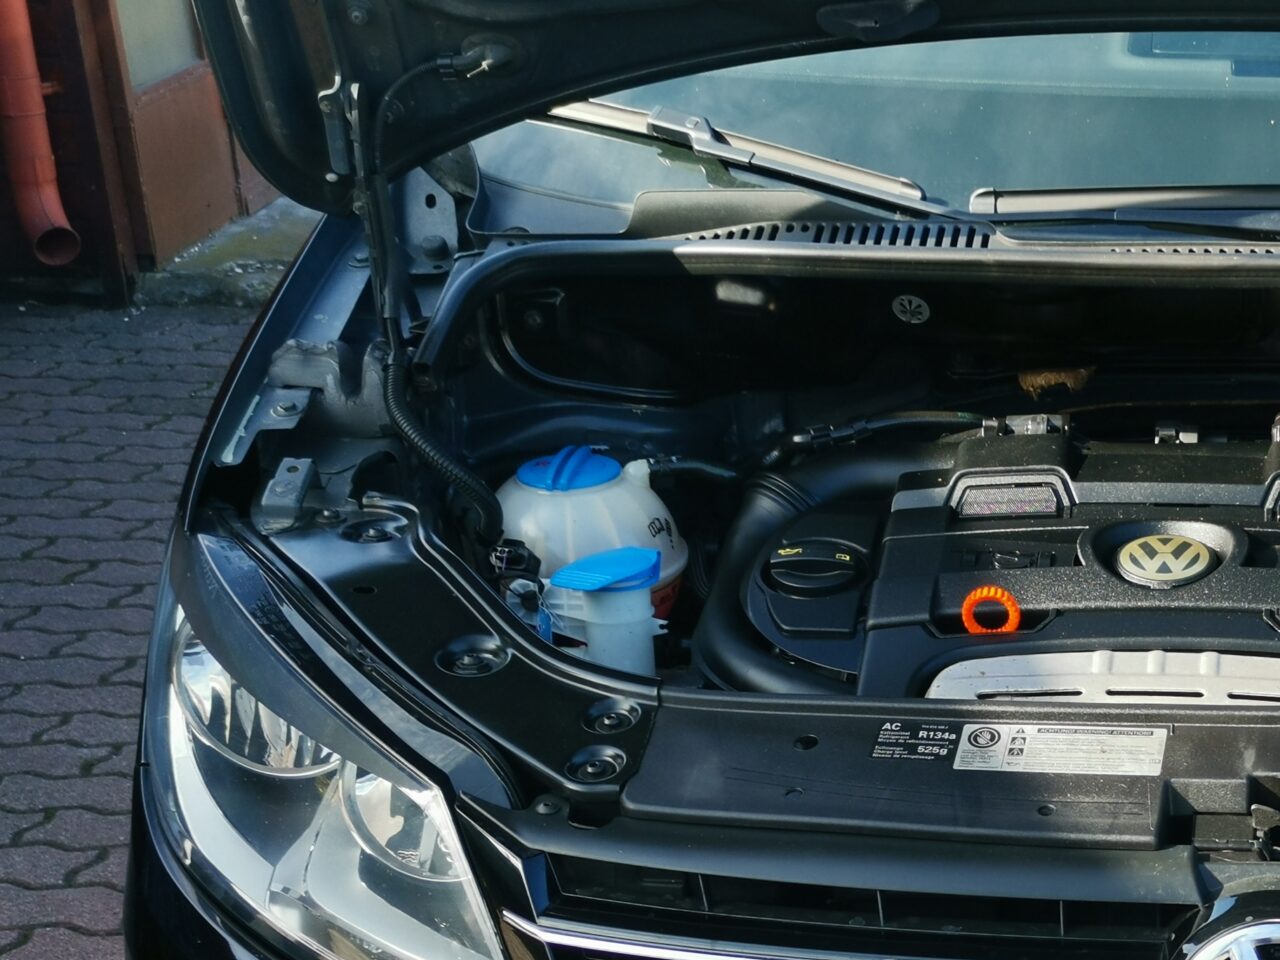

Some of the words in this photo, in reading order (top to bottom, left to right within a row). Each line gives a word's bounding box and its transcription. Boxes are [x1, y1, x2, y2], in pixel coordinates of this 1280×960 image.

[881, 722, 902, 730] AC
[918, 730, 957, 740] R134a
[917, 745, 948, 755] 525g
